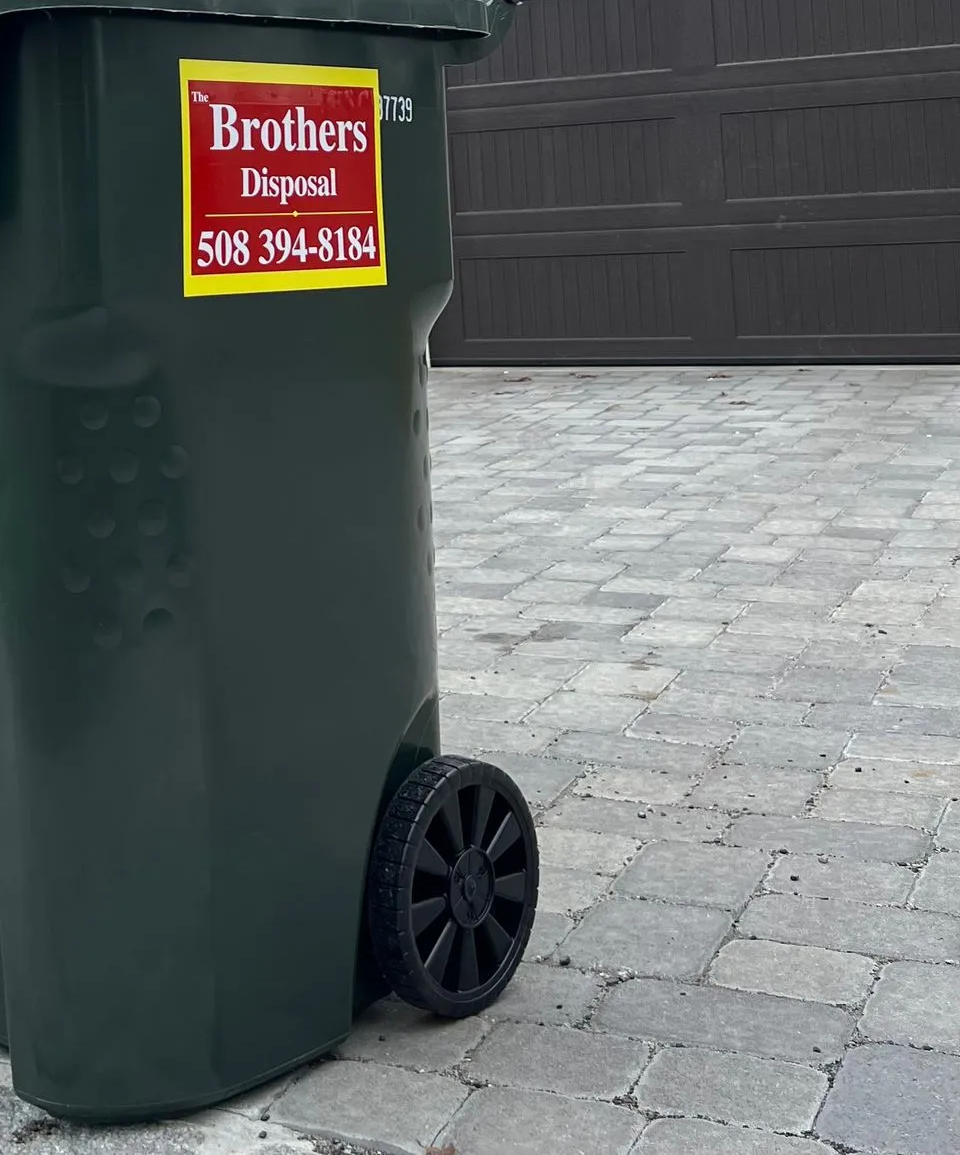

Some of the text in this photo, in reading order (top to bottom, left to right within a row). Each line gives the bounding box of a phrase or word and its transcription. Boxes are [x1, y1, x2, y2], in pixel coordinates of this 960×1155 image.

[191, 91, 209, 103] The
[209, 103, 368, 153] Brothers
[240, 167, 337, 204] Disposal
[197, 226, 376, 268] 508 394-8184
